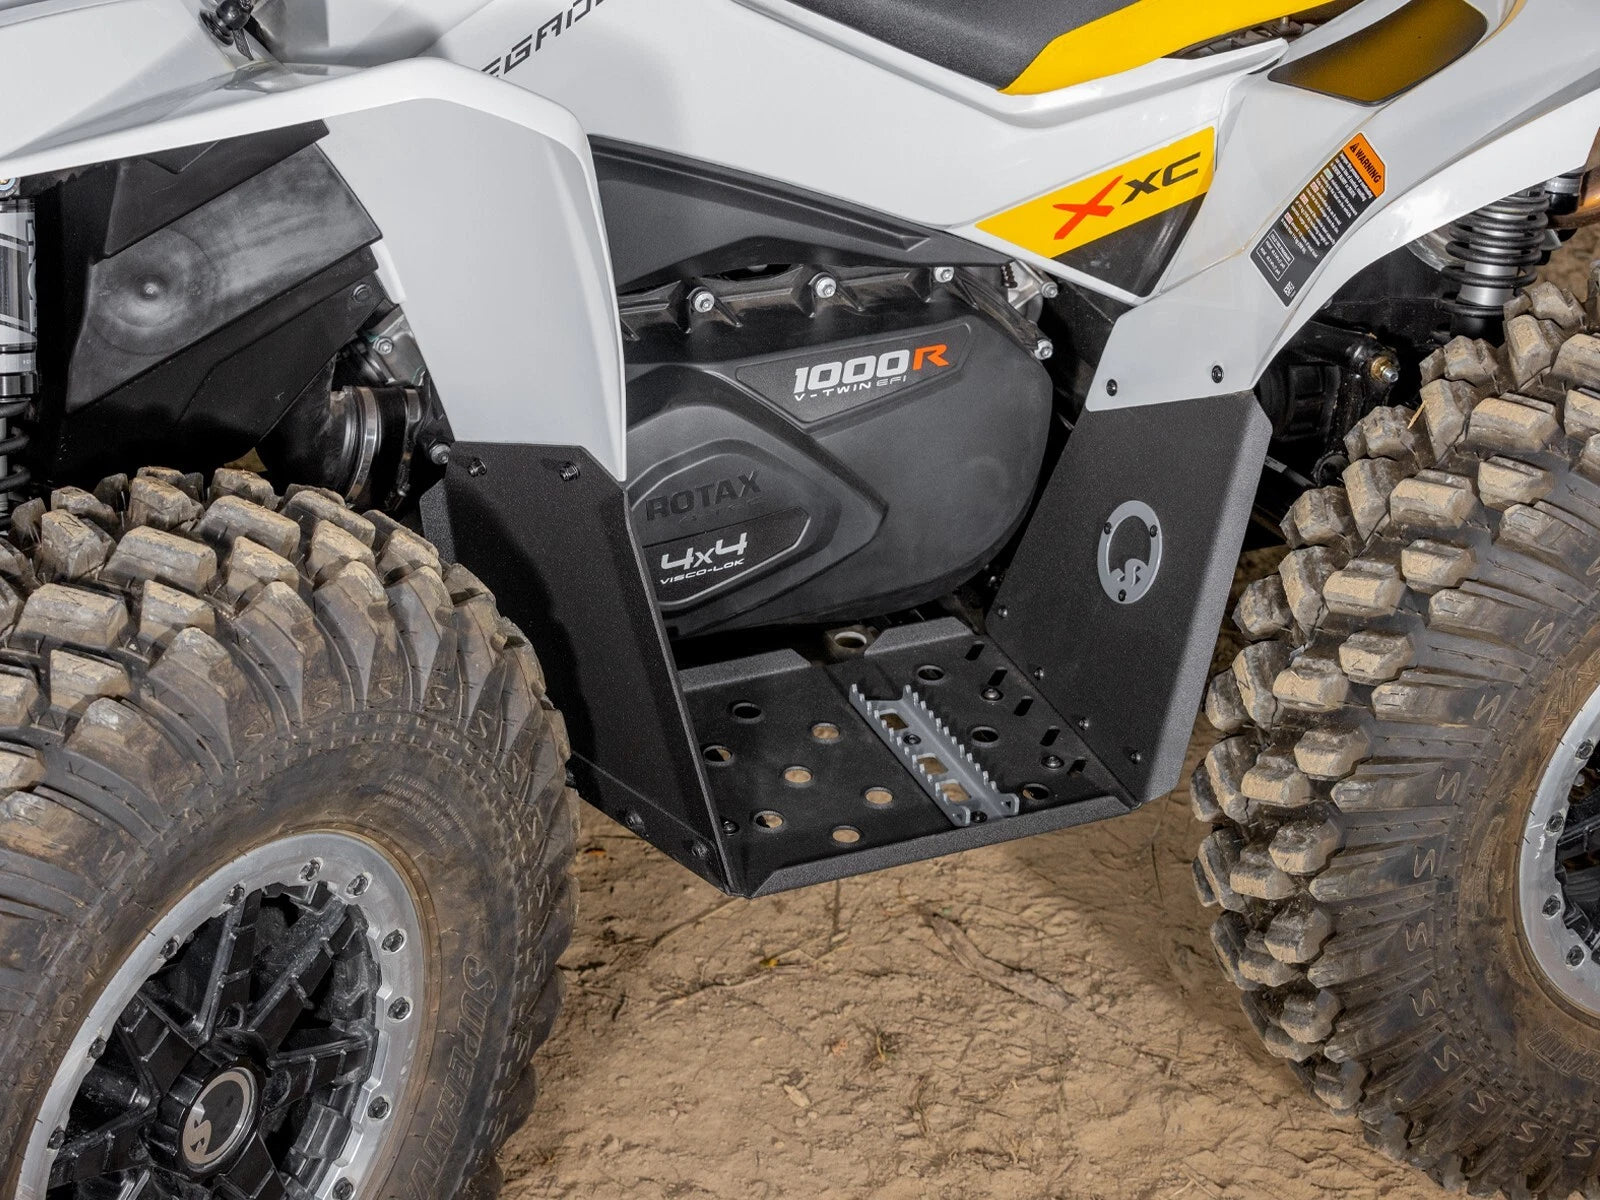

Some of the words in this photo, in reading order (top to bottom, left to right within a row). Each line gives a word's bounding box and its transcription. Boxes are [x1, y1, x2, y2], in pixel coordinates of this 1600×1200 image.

[1355, 148, 1382, 184] WARNING
[876, 375, 907, 388] EFI
[646, 470, 762, 521] ROTAX
[660, 558, 745, 585] VISCO-LOK
